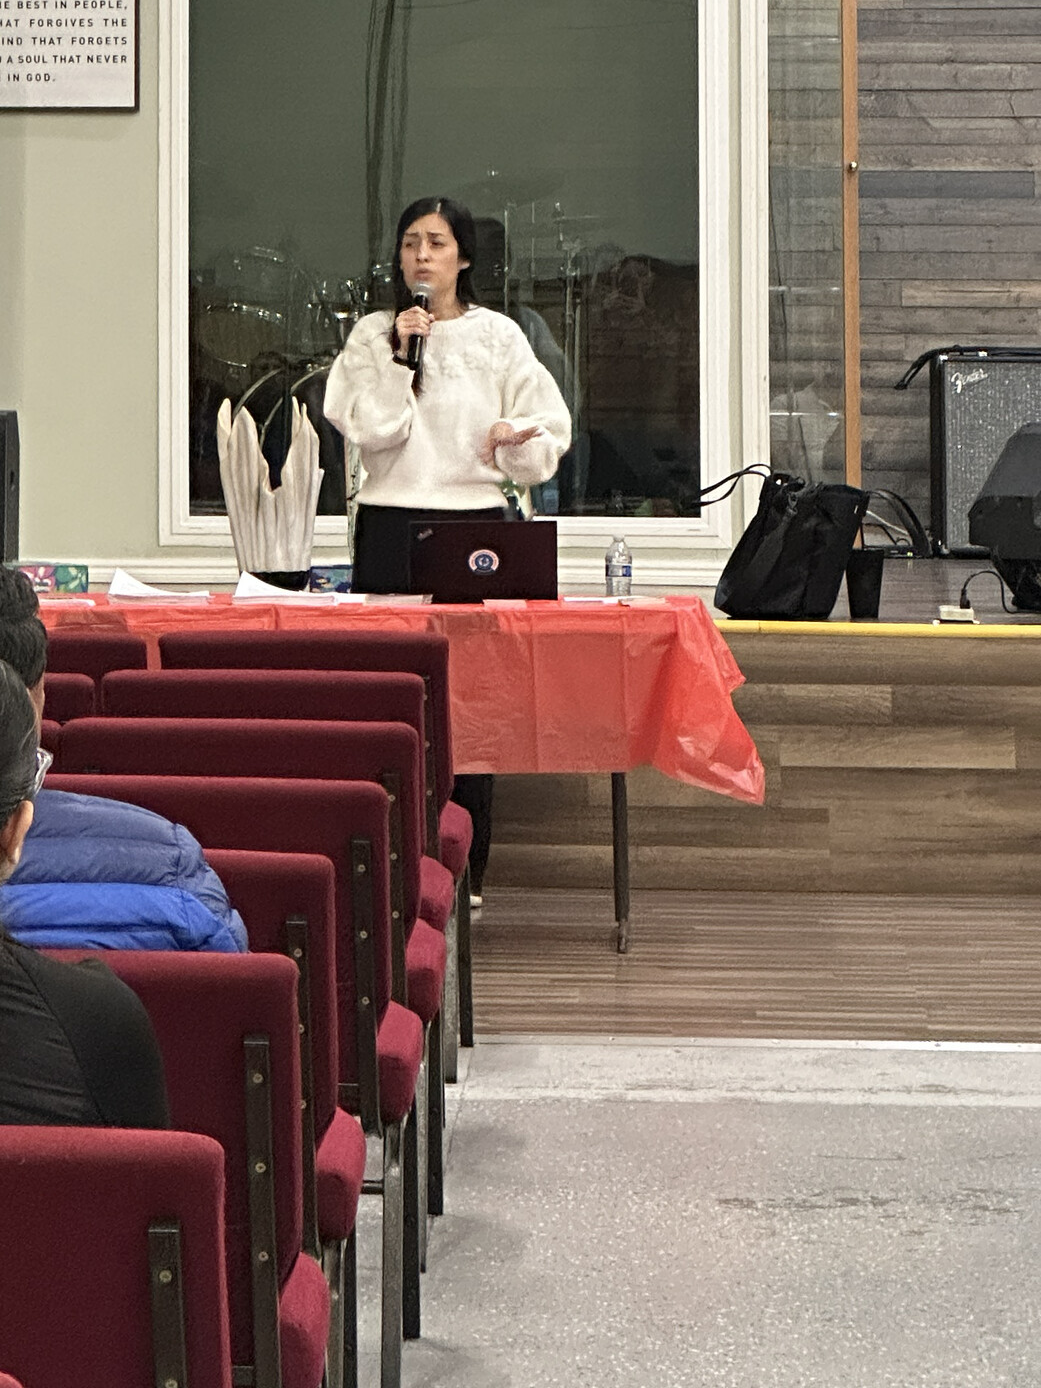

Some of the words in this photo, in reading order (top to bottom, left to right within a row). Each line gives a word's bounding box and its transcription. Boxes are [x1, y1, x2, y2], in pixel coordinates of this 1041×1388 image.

[17, 1, 48, 9] BEST
[54, 0, 67, 9] IN
[74, 0, 128, 10] PEOPLE,
[29, 19, 94, 27] FORGIVES
[103, 19, 128, 27] THE
[31, 37, 63, 45] THAT
[71, 37, 128, 45] FORGETS
[7, 55, 13, 64] A
[17, 55, 48, 64] SOUL
[52, 55, 81, 64] THAT
[86, 55, 128, 63] NEVER
[7, 74, 20, 82] IN
[26, 74, 56, 82] GOD.
